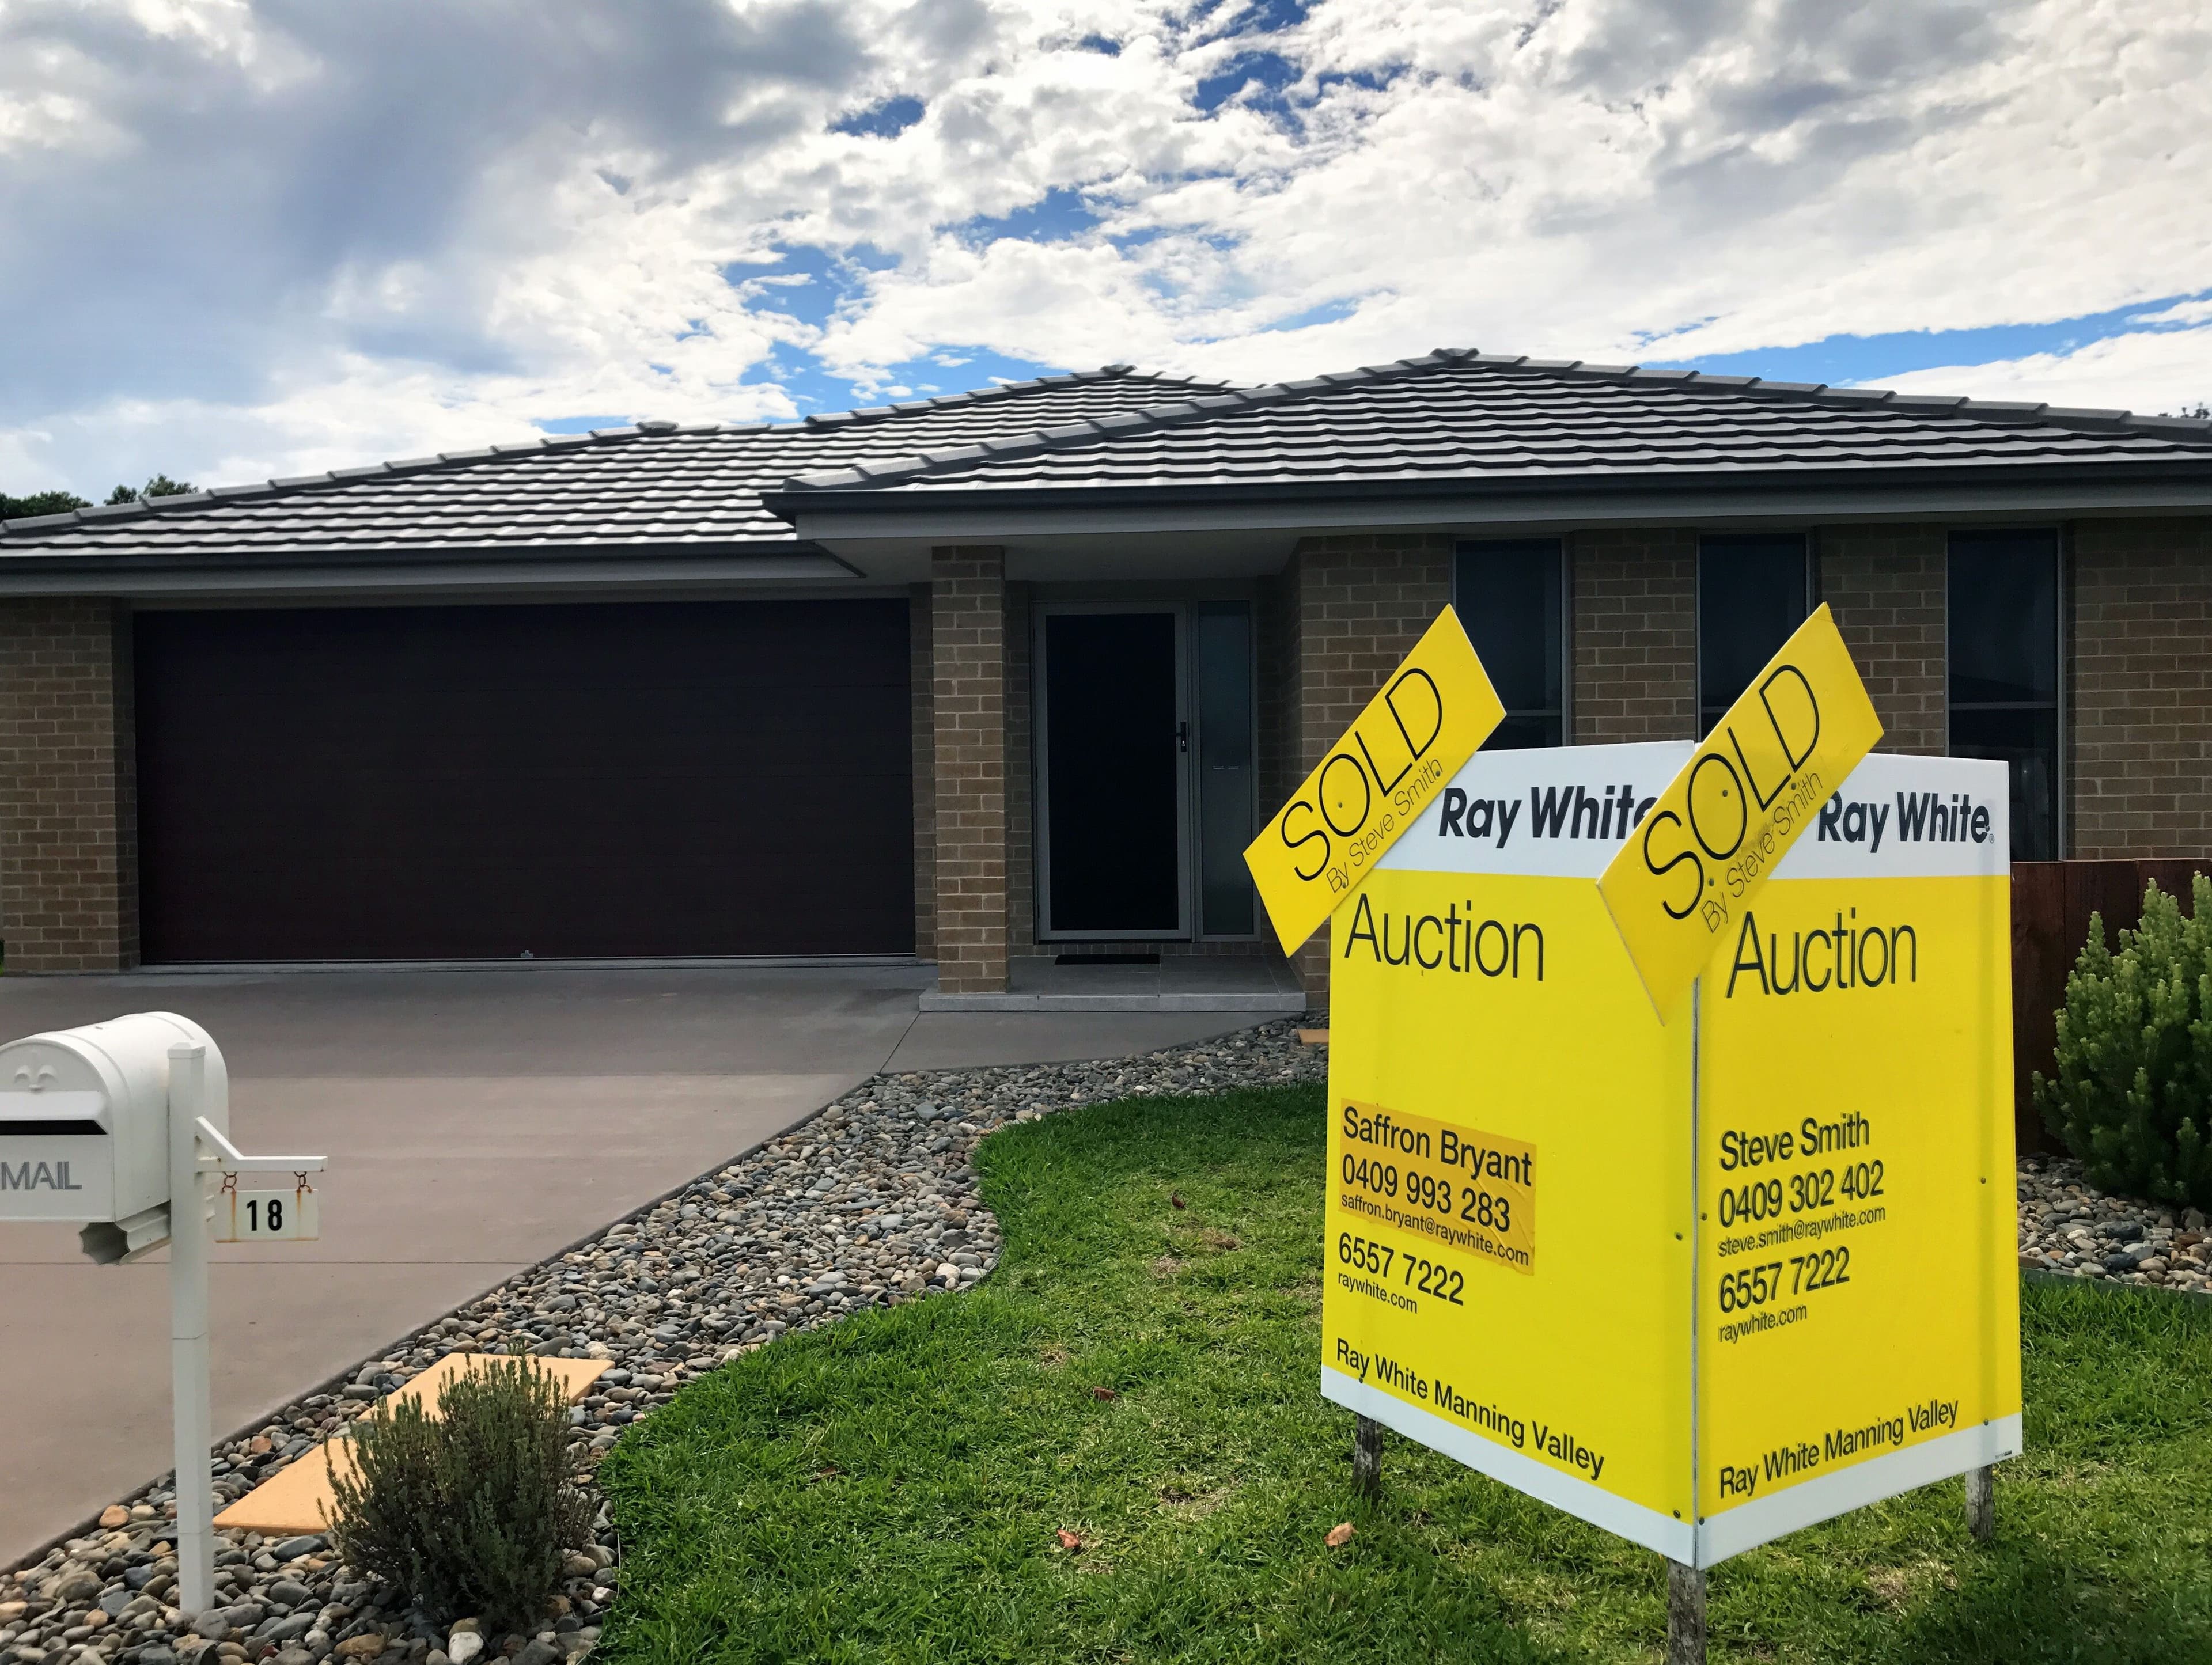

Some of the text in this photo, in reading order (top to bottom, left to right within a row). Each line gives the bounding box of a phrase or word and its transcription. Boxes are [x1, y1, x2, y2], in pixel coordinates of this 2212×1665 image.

[1281, 668, 1442, 881] SOLD
[1643, 665, 1820, 920] SOLD
[1327, 759, 1443, 893] By Steve Smith
[1439, 788, 1522, 849] Ray
[1700, 773, 1823, 933] By Steve Smith
[1817, 790, 1890, 853] Ray
[1344, 893, 1544, 982] Auction
[1726, 907, 1916, 998] Auction
[1, 1161, 82, 1190] MAIL
[1343, 1106, 1532, 1186] Saffron Bryant
[1719, 1110, 1870, 1171] Steve Smith
[247, 1199, 283, 1232] 18
[1342, 1154, 1510, 1232] 0409 993 283
[1719, 1159, 1884, 1228] 0409 302 402
[1341, 1194, 1529, 1266] saffron.bryant@raywhite.com
[1718, 1205, 1886, 1257] steve.smith@raywhite.com
[1338, 1232, 1464, 1306] 6557 7222
[1338, 1272, 1418, 1314] raywhite.com
[1719, 1245, 1850, 1314] 6557 7222
[1718, 1303, 1808, 1344] raywhite.com
[1336, 1338, 1605, 1481] Ray White Manning Valley
[1719, 1399, 1959, 1500] Ray White Manning Valley
